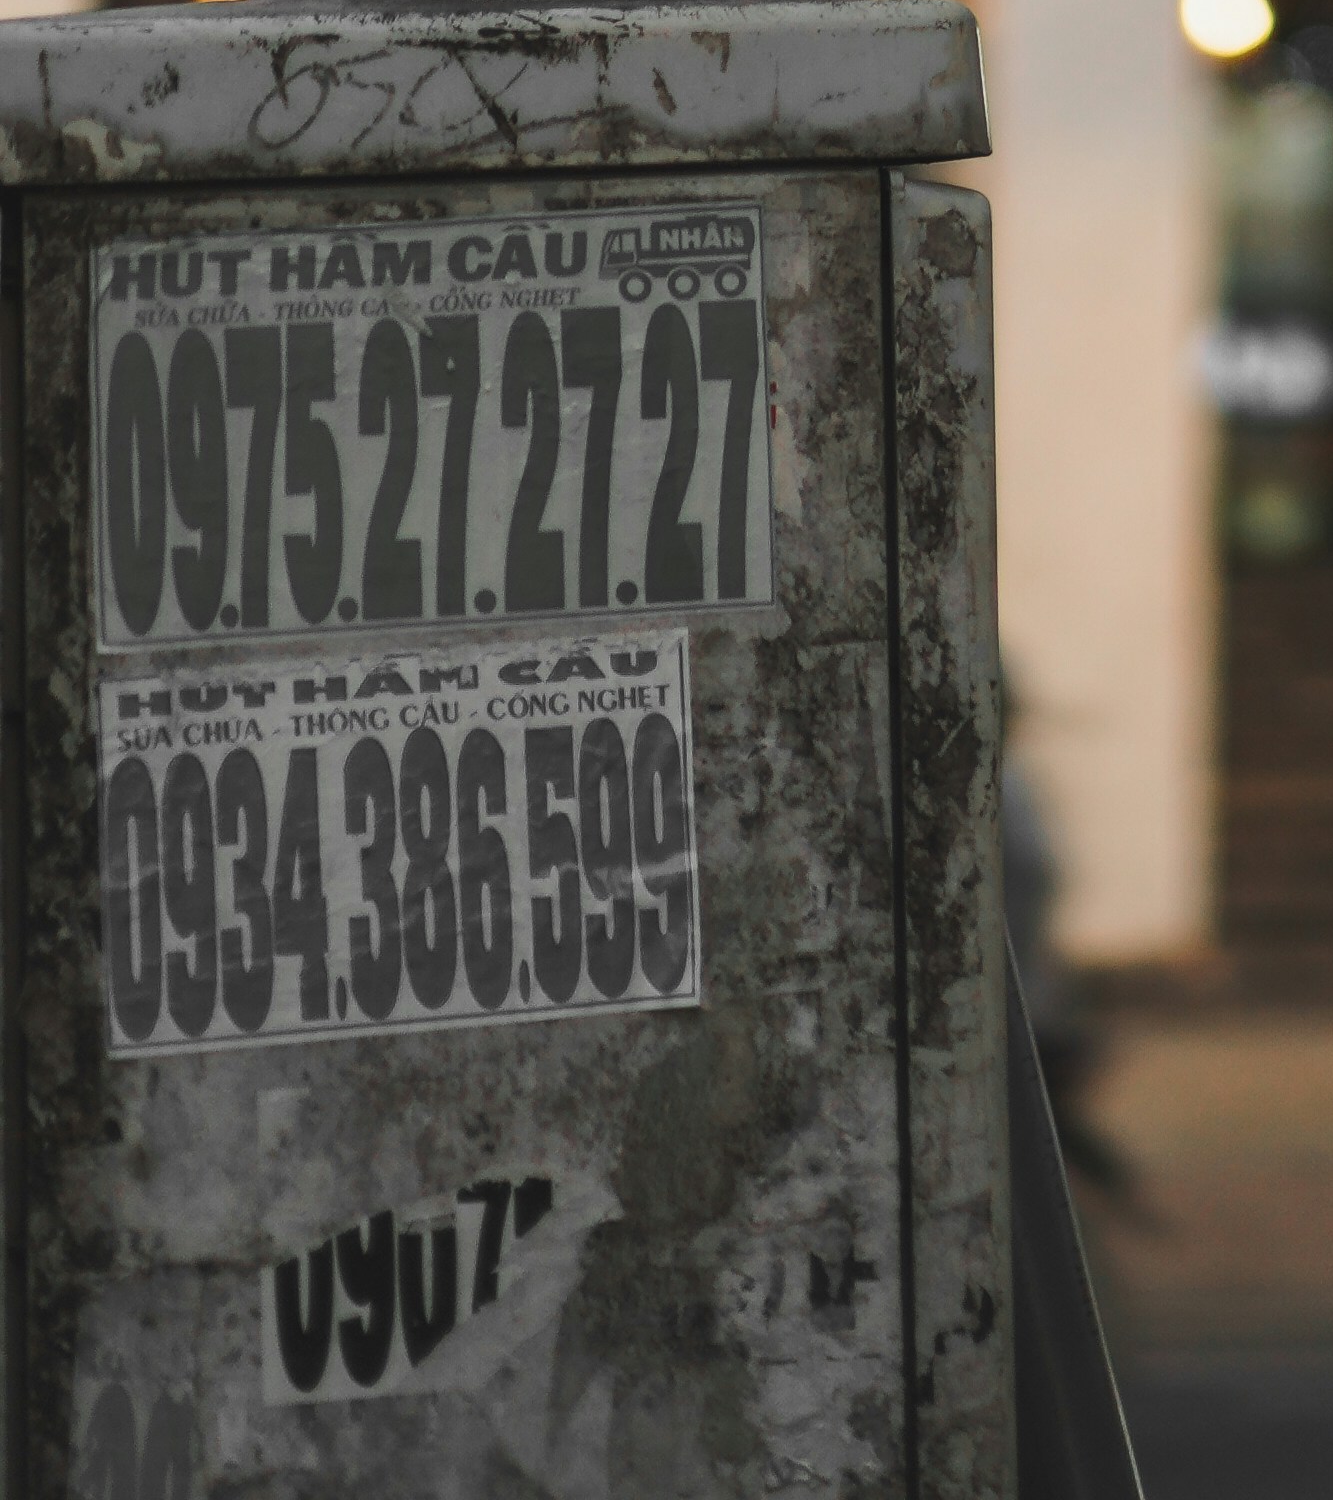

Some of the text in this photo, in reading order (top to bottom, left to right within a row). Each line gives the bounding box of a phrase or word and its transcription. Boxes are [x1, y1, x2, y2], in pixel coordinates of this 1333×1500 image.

[446, 223, 588, 282] CẦU
[659, 222, 744, 252] NHÂN
[107, 712, 690, 1041] 0934.386.599
